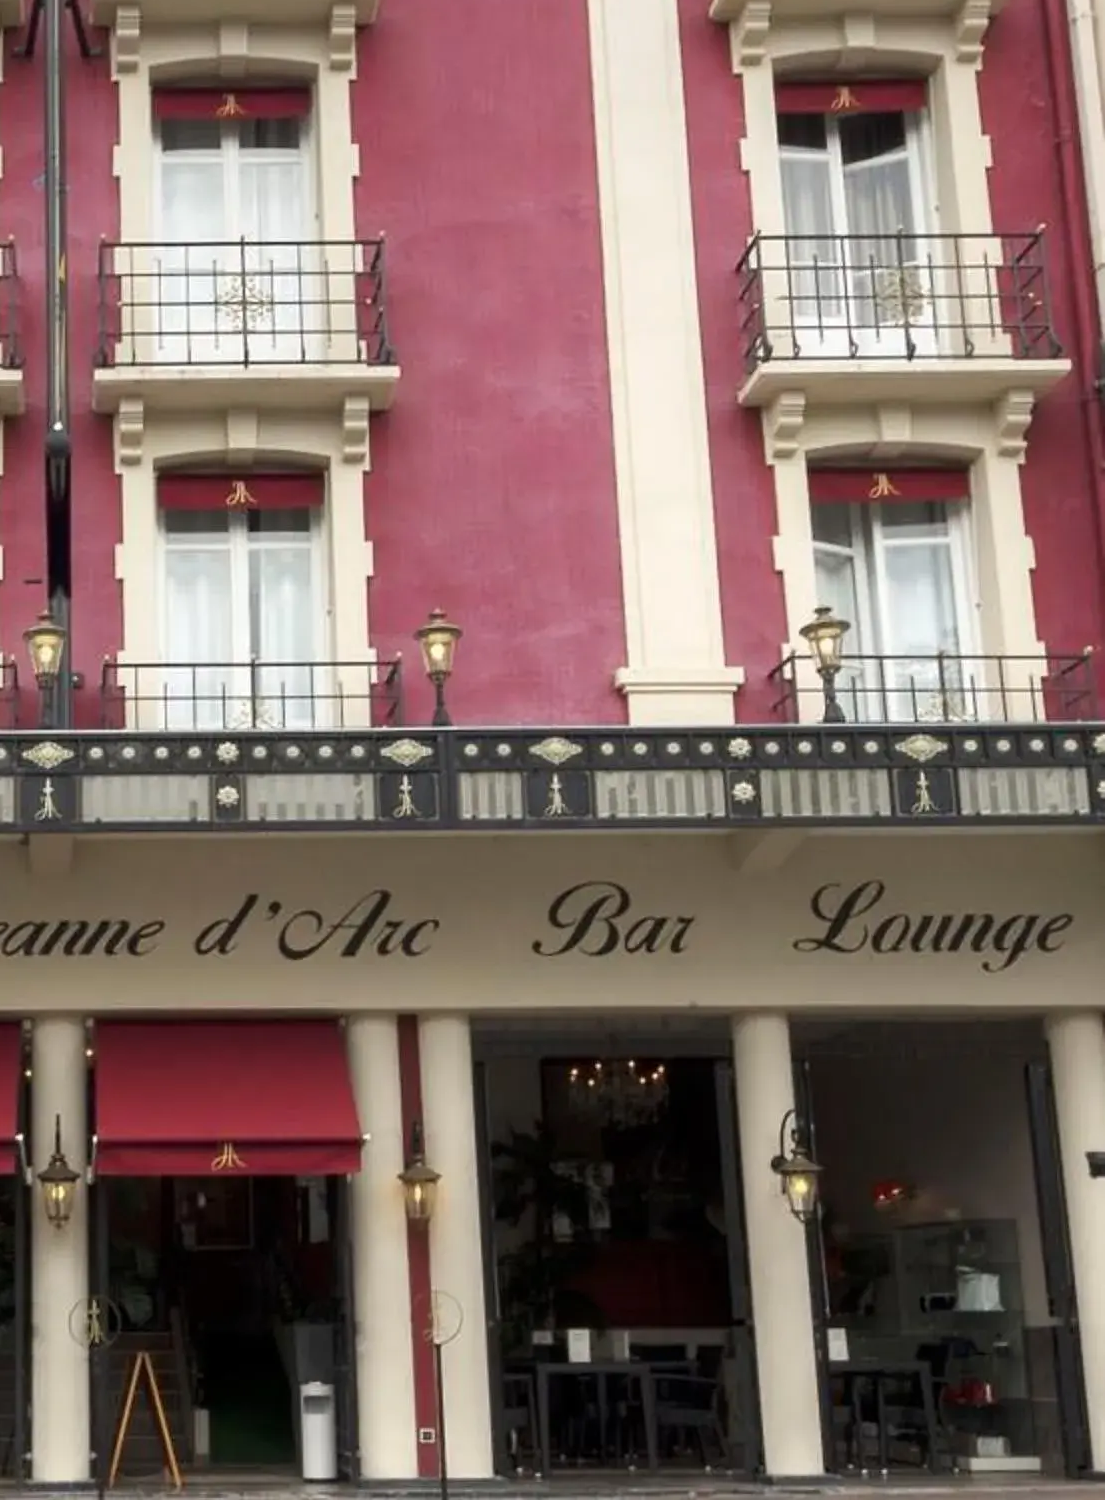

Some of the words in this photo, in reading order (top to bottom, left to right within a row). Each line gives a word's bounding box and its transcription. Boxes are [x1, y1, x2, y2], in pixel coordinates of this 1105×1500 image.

[194, 889, 441, 961] d'Arc
[531, 880, 696, 957] Bar
[792, 879, 1075, 972] Lounge
